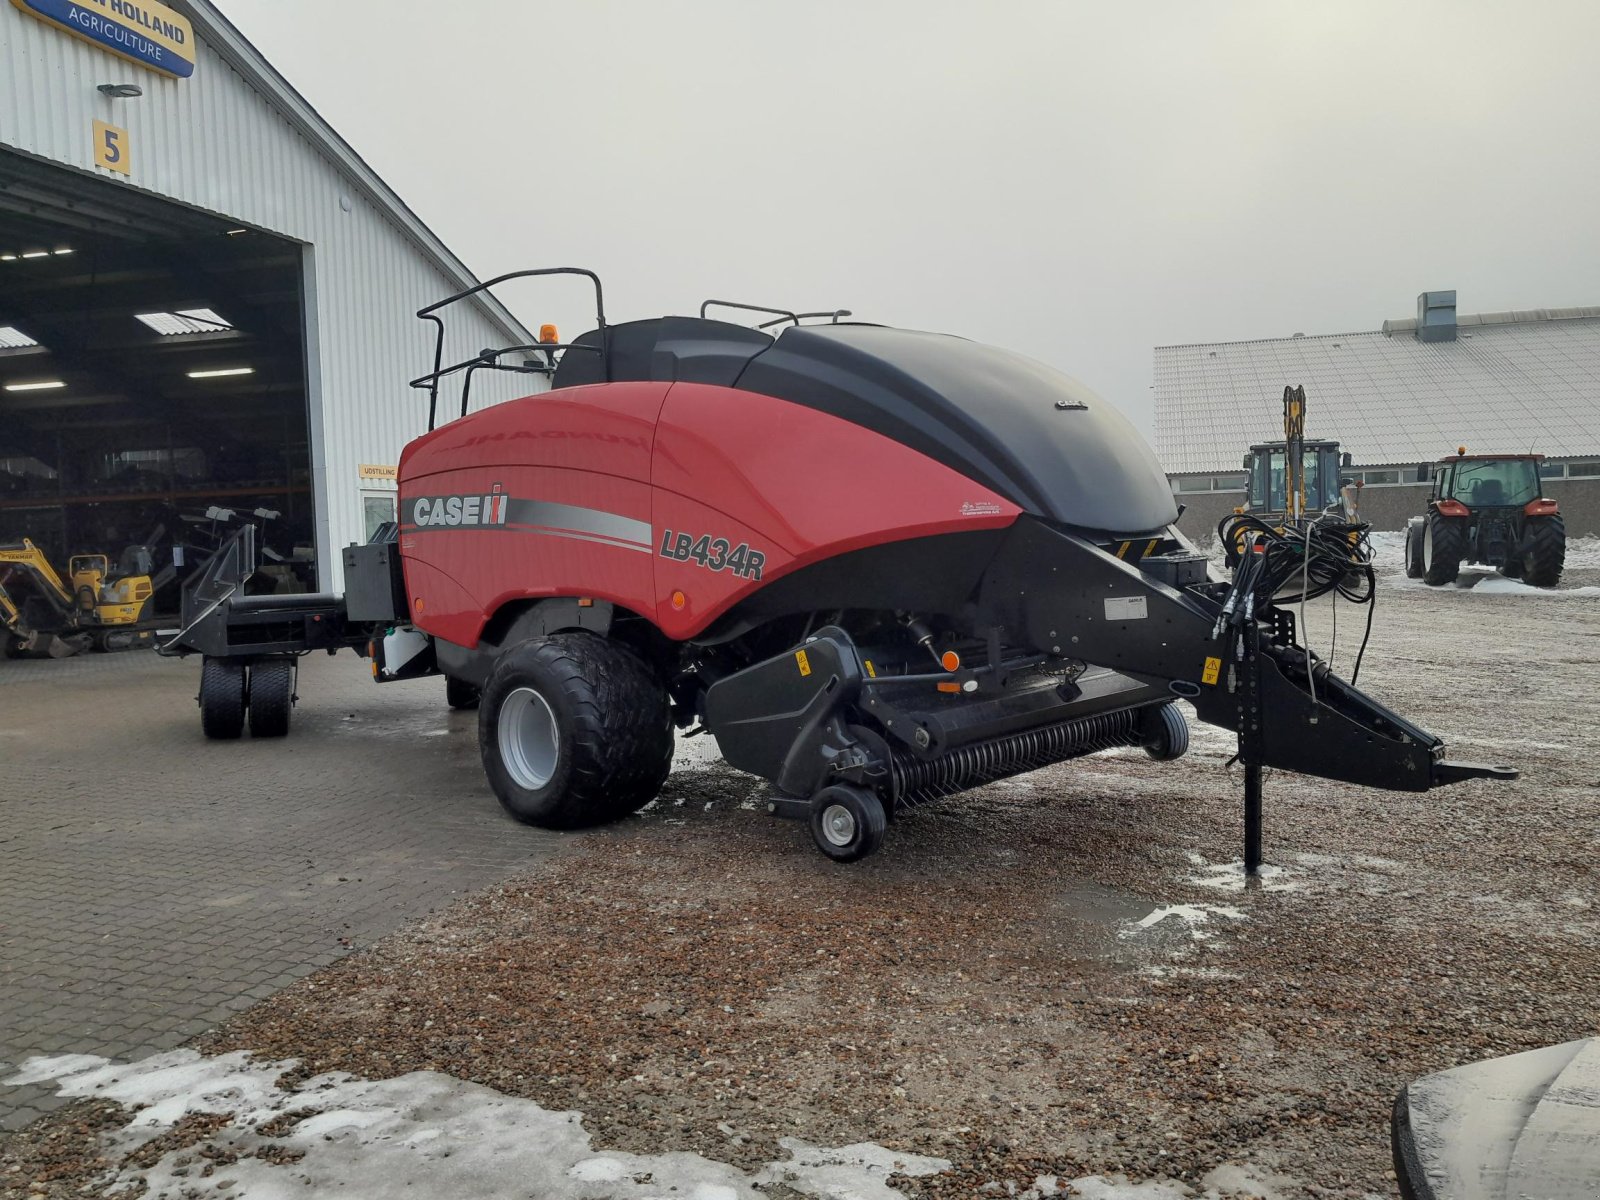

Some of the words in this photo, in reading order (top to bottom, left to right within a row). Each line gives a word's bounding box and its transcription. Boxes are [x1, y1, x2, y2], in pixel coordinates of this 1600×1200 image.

[68, 7, 162, 61] AGRICULTURE
[110, 0, 185, 45] HOLLAND
[104, 130, 120, 163] 5
[364, 467, 396, 476] UDSTILLING
[413, 496, 481, 527] CASE
[659, 529, 766, 581] LB434R
